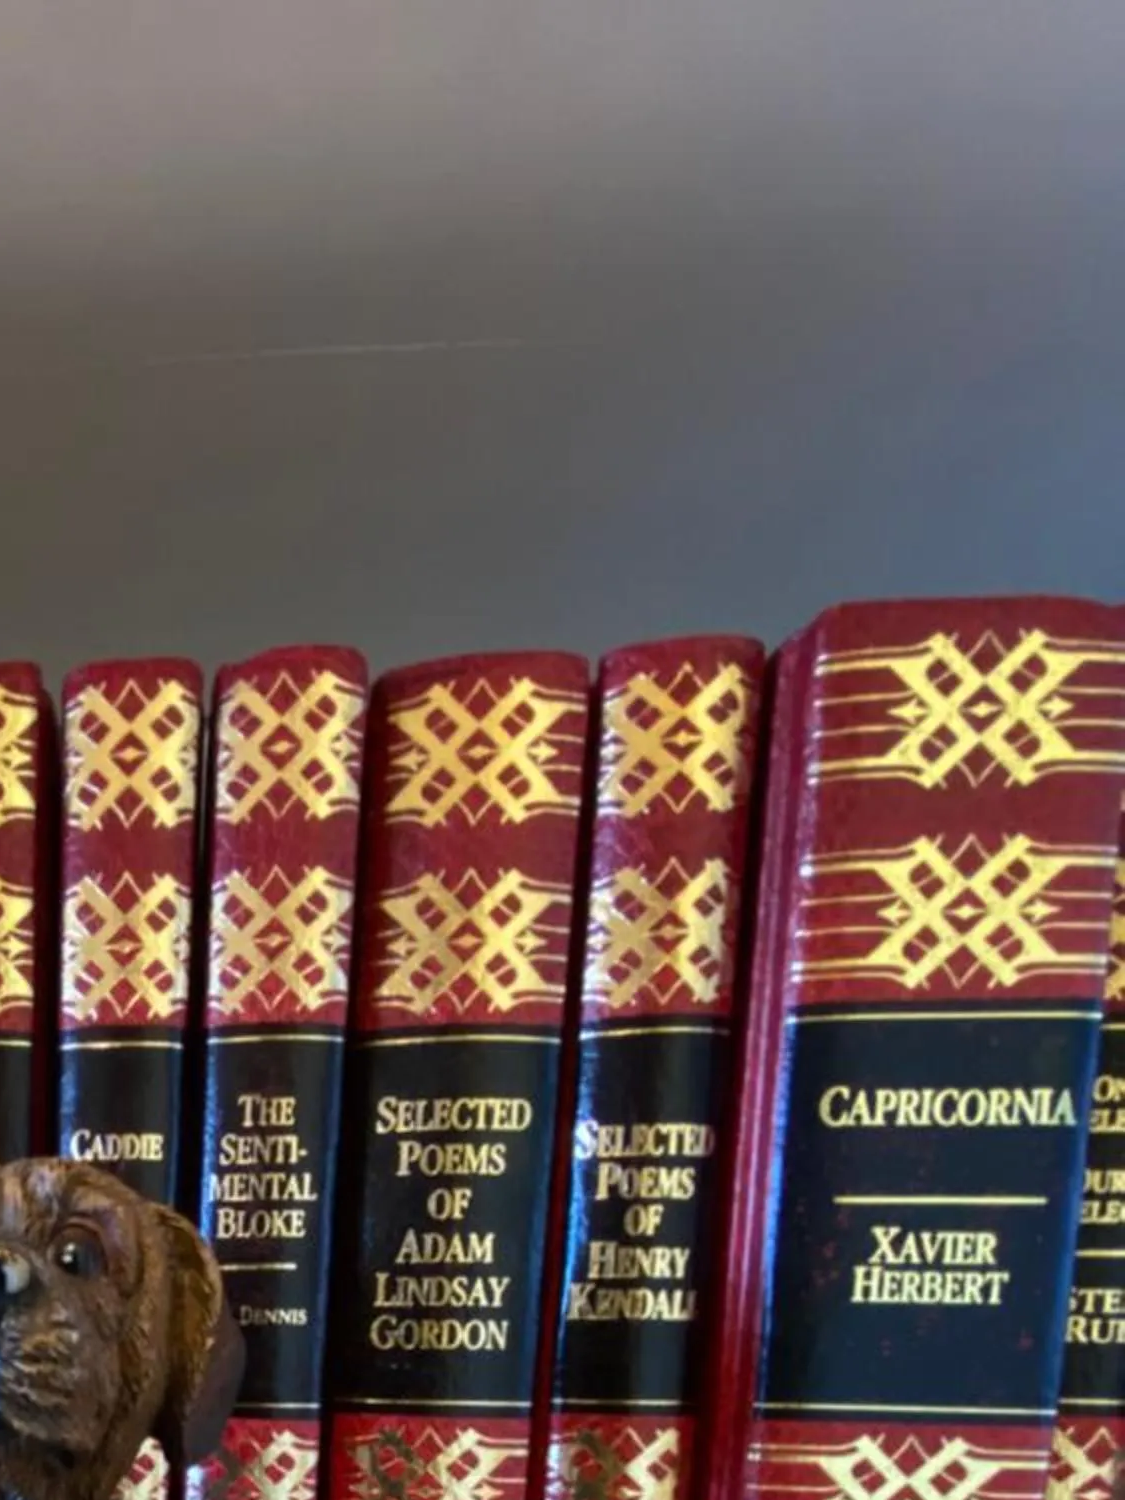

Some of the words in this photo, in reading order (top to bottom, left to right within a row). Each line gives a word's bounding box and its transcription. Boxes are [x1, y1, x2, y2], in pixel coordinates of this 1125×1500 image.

[238, 1094, 296, 1127] THE
[375, 1096, 532, 1134] SELECTED
[818, 1085, 1078, 1128] CAPRICORNIA
[70, 1129, 164, 1162] CADDIE
[218, 1133, 308, 1166] SENTI-
[573, 1119, 715, 1160] SELECTED
[396, 1142, 506, 1177] POEMS
[209, 1172, 318, 1202] MENTAL
[595, 1160, 696, 1200] POEMS
[427, 1189, 471, 1220] OF
[623, 1203, 664, 1236] OF
[216, 1207, 307, 1239] BLOKE
[395, 1229, 495, 1264] ADAM
[588, 1240, 690, 1279] HENRY
[868, 1226, 998, 1265] XAVIER
[374, 1272, 511, 1308] LINDSAY
[850, 1266, 1010, 1304] HERBERT
[369, 1315, 508, 1351] GORDON
